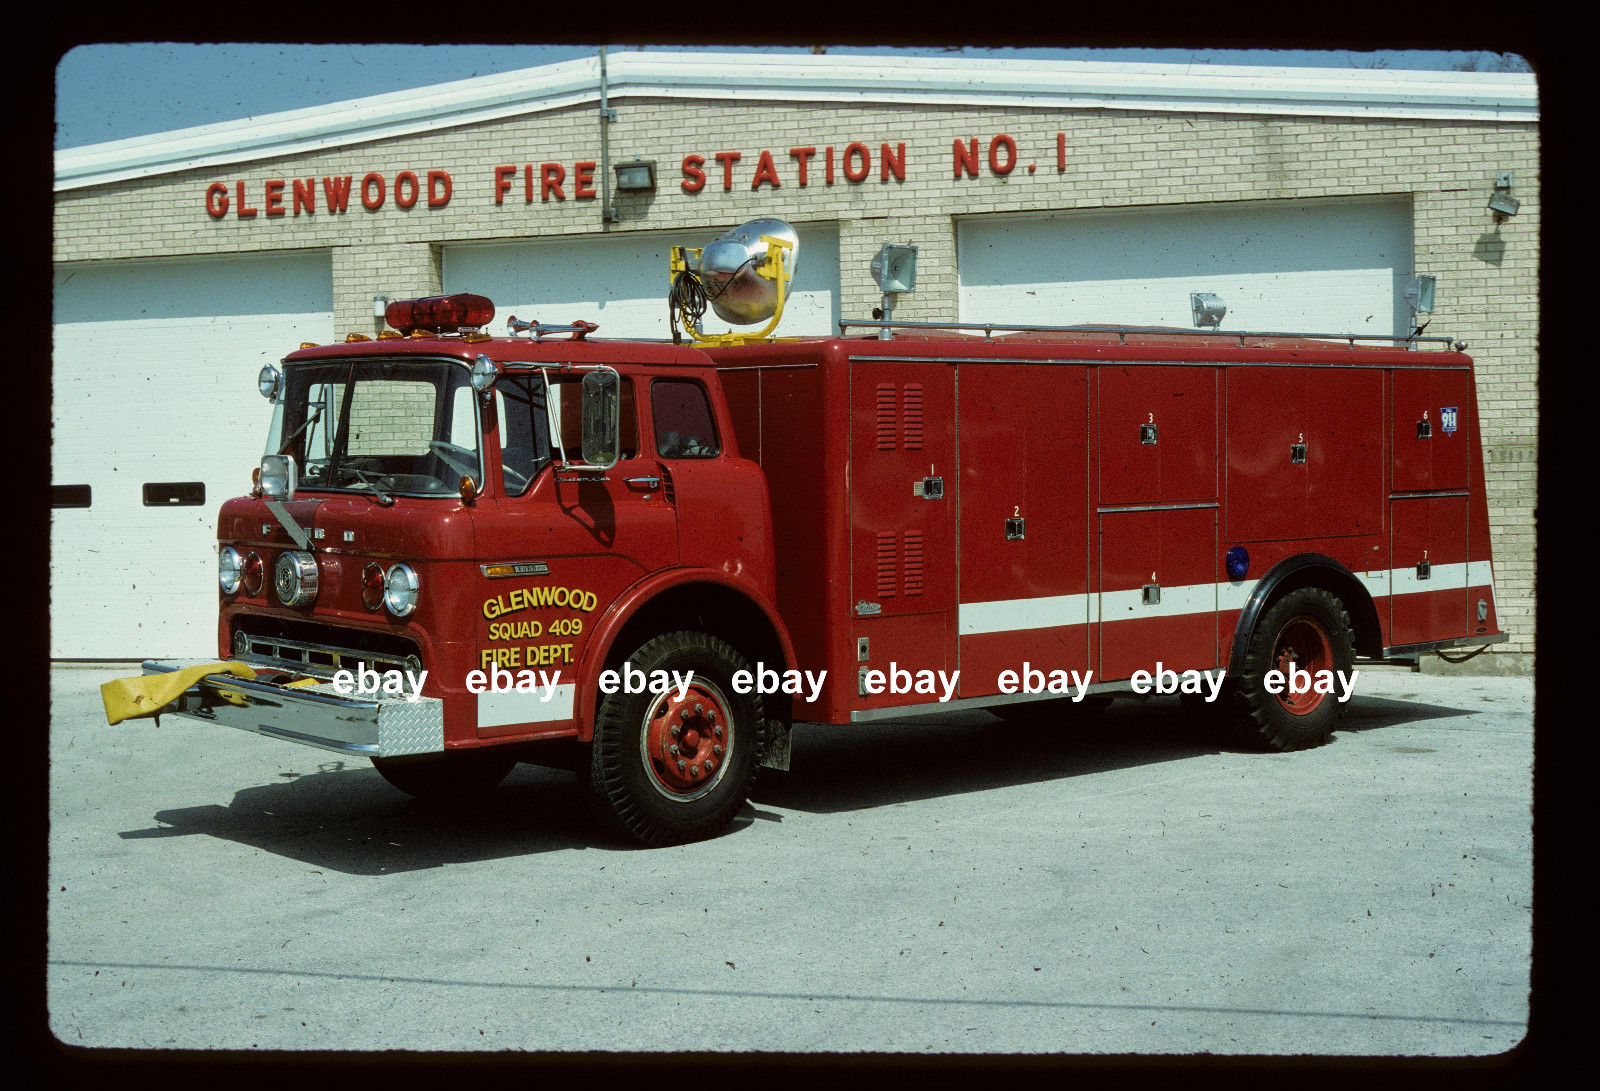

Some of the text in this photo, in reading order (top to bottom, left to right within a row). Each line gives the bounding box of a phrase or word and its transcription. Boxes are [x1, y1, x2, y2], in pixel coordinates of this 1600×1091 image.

[205, 169, 453, 218] GLENWOOD
[495, 161, 597, 204] FIRE
[681, 141, 906, 192] STATION
[1148, 412, 1154, 424] 3
[1423, 410, 1429, 420] 6
[1442, 412, 1457, 427] 911
[1298, 433, 1304, 443] 5
[1014, 505, 1020, 517] 2
[262, 524, 355, 542] FRD
[1423, 550, 1428, 560] 7
[1151, 571, 1157, 583] 4
[483, 586, 598, 620] GLENWOOD
[488, 618, 584, 642] SQUAD 409
[481, 643, 575, 670] FIRE DEPT.
